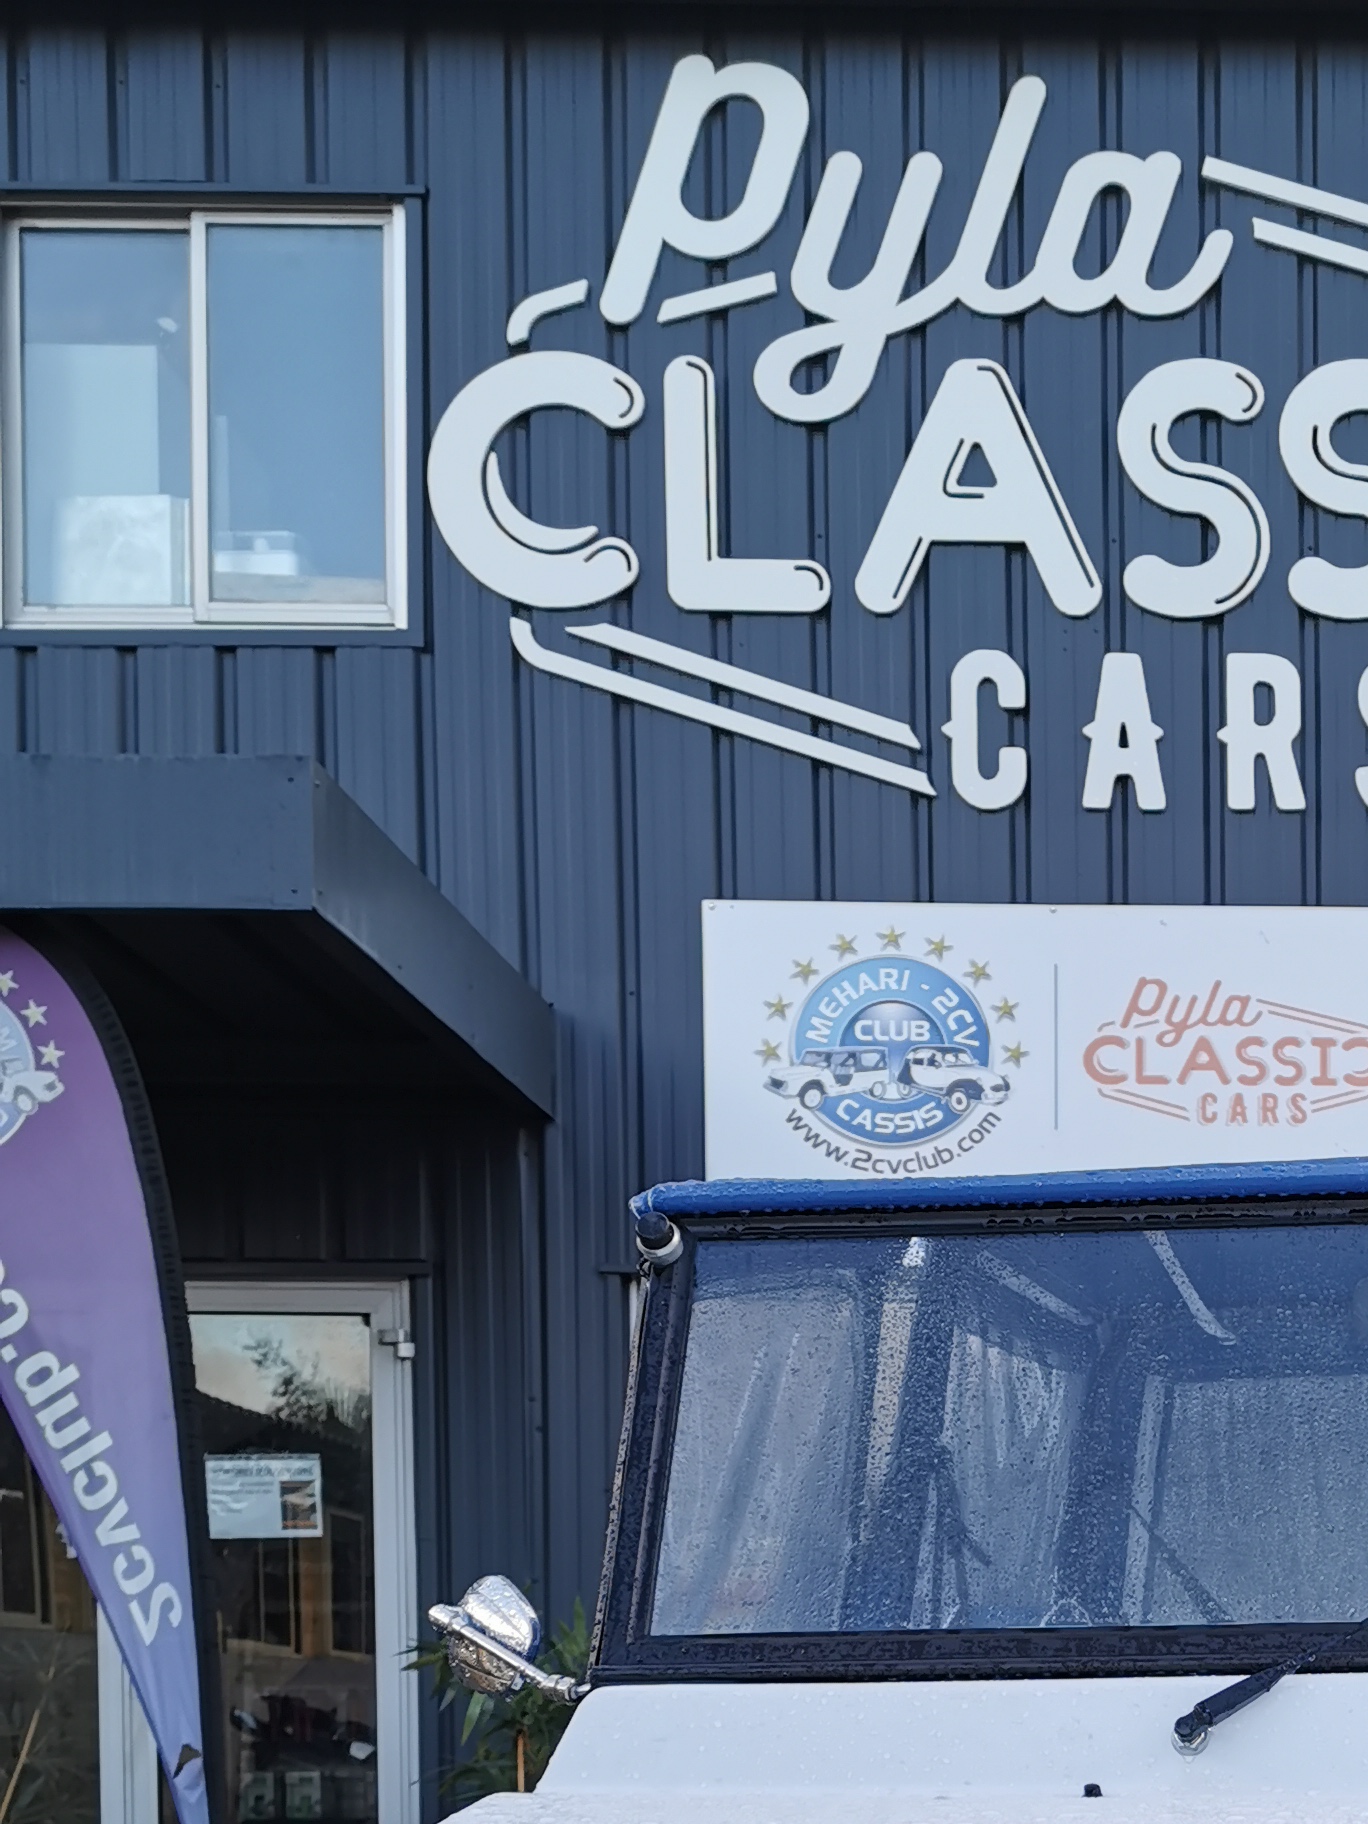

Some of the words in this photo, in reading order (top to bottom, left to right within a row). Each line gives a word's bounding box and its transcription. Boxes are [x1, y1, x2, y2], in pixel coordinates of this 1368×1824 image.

[599, 54, 1233, 422] Pyla
[806, 967, 910, 1044] MEHARI
[932, 987, 980, 1047] 2CV
[853, 1019, 931, 1042] CLUB
[1120, 976, 1263, 1048] Pyla
[785, 1107, 1002, 1175] www.2cvclub.com
[835, 1098, 944, 1135] CASSIS
[1197, 1091, 1308, 1128] CARS
